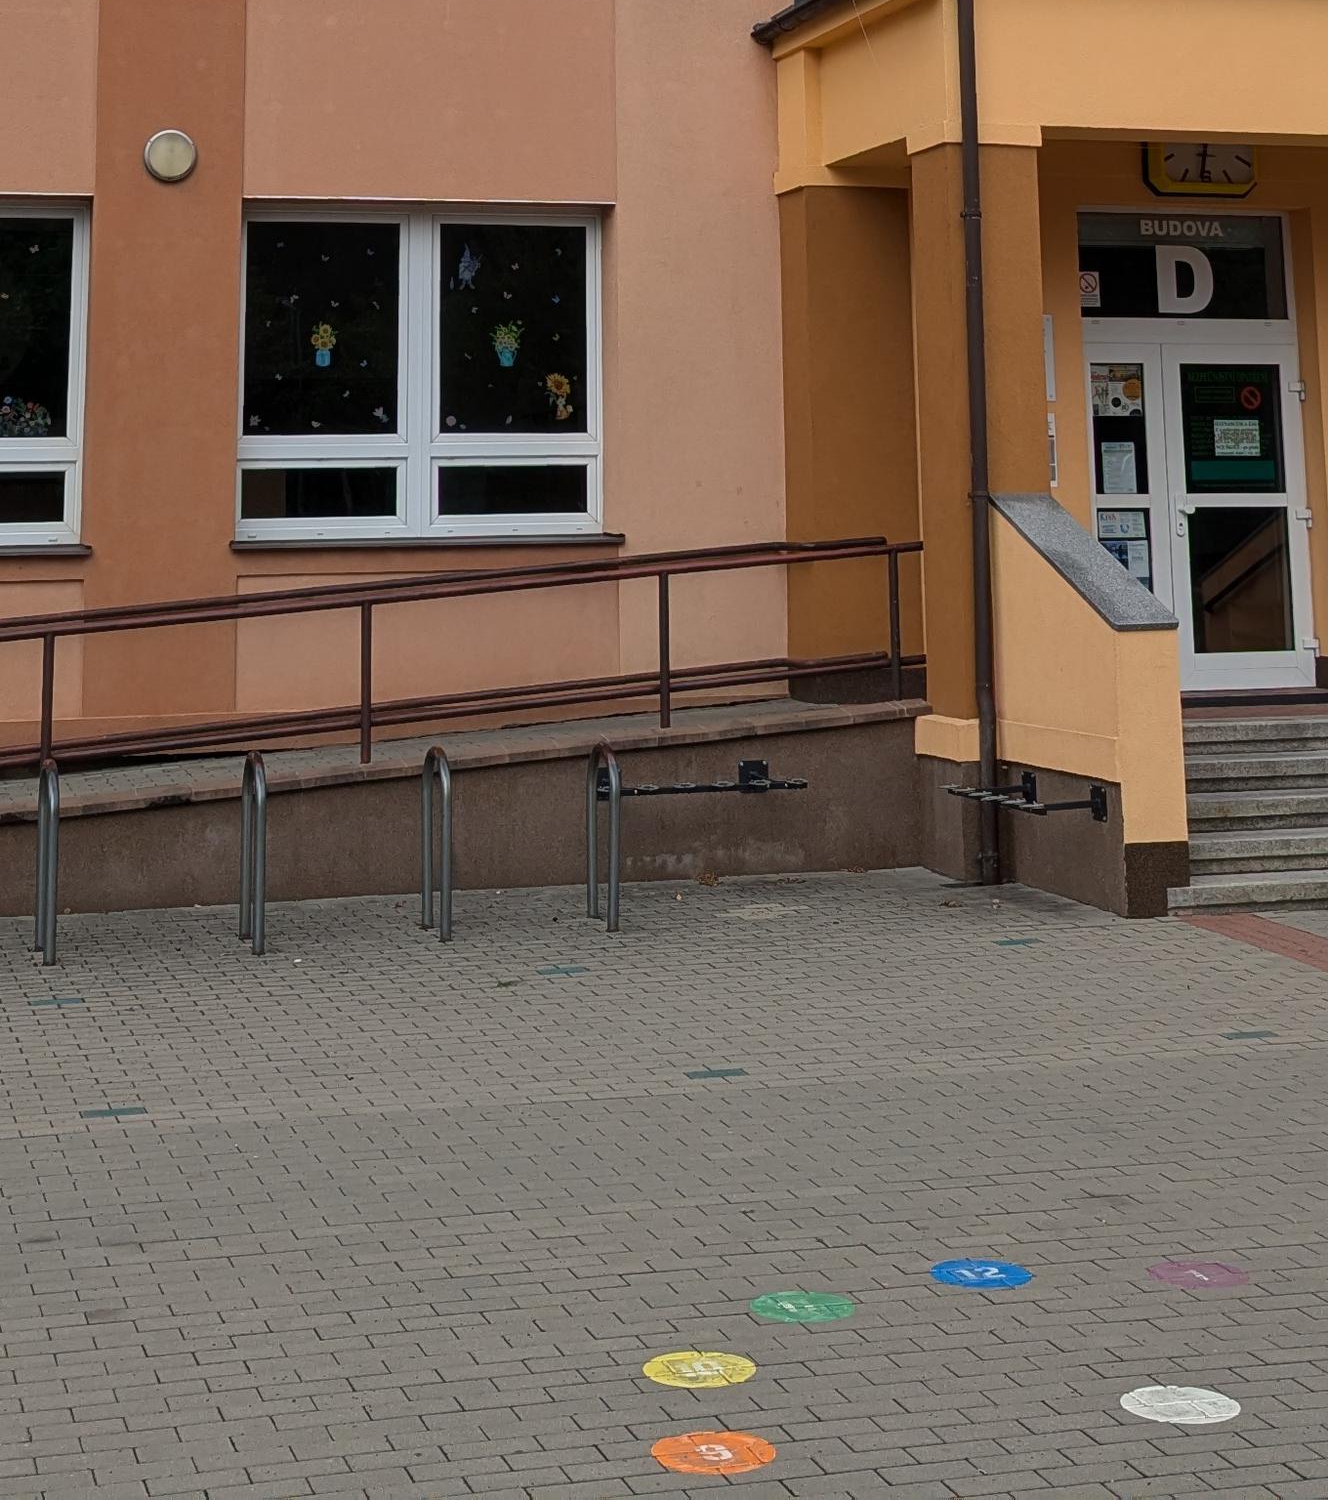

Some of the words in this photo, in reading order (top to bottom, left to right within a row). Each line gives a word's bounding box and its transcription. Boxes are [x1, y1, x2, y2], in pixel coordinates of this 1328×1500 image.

[1140, 219, 1224, 237] BUDOVA
[1155, 244, 1214, 314] D
[955, 1266, 1006, 1279] 12
